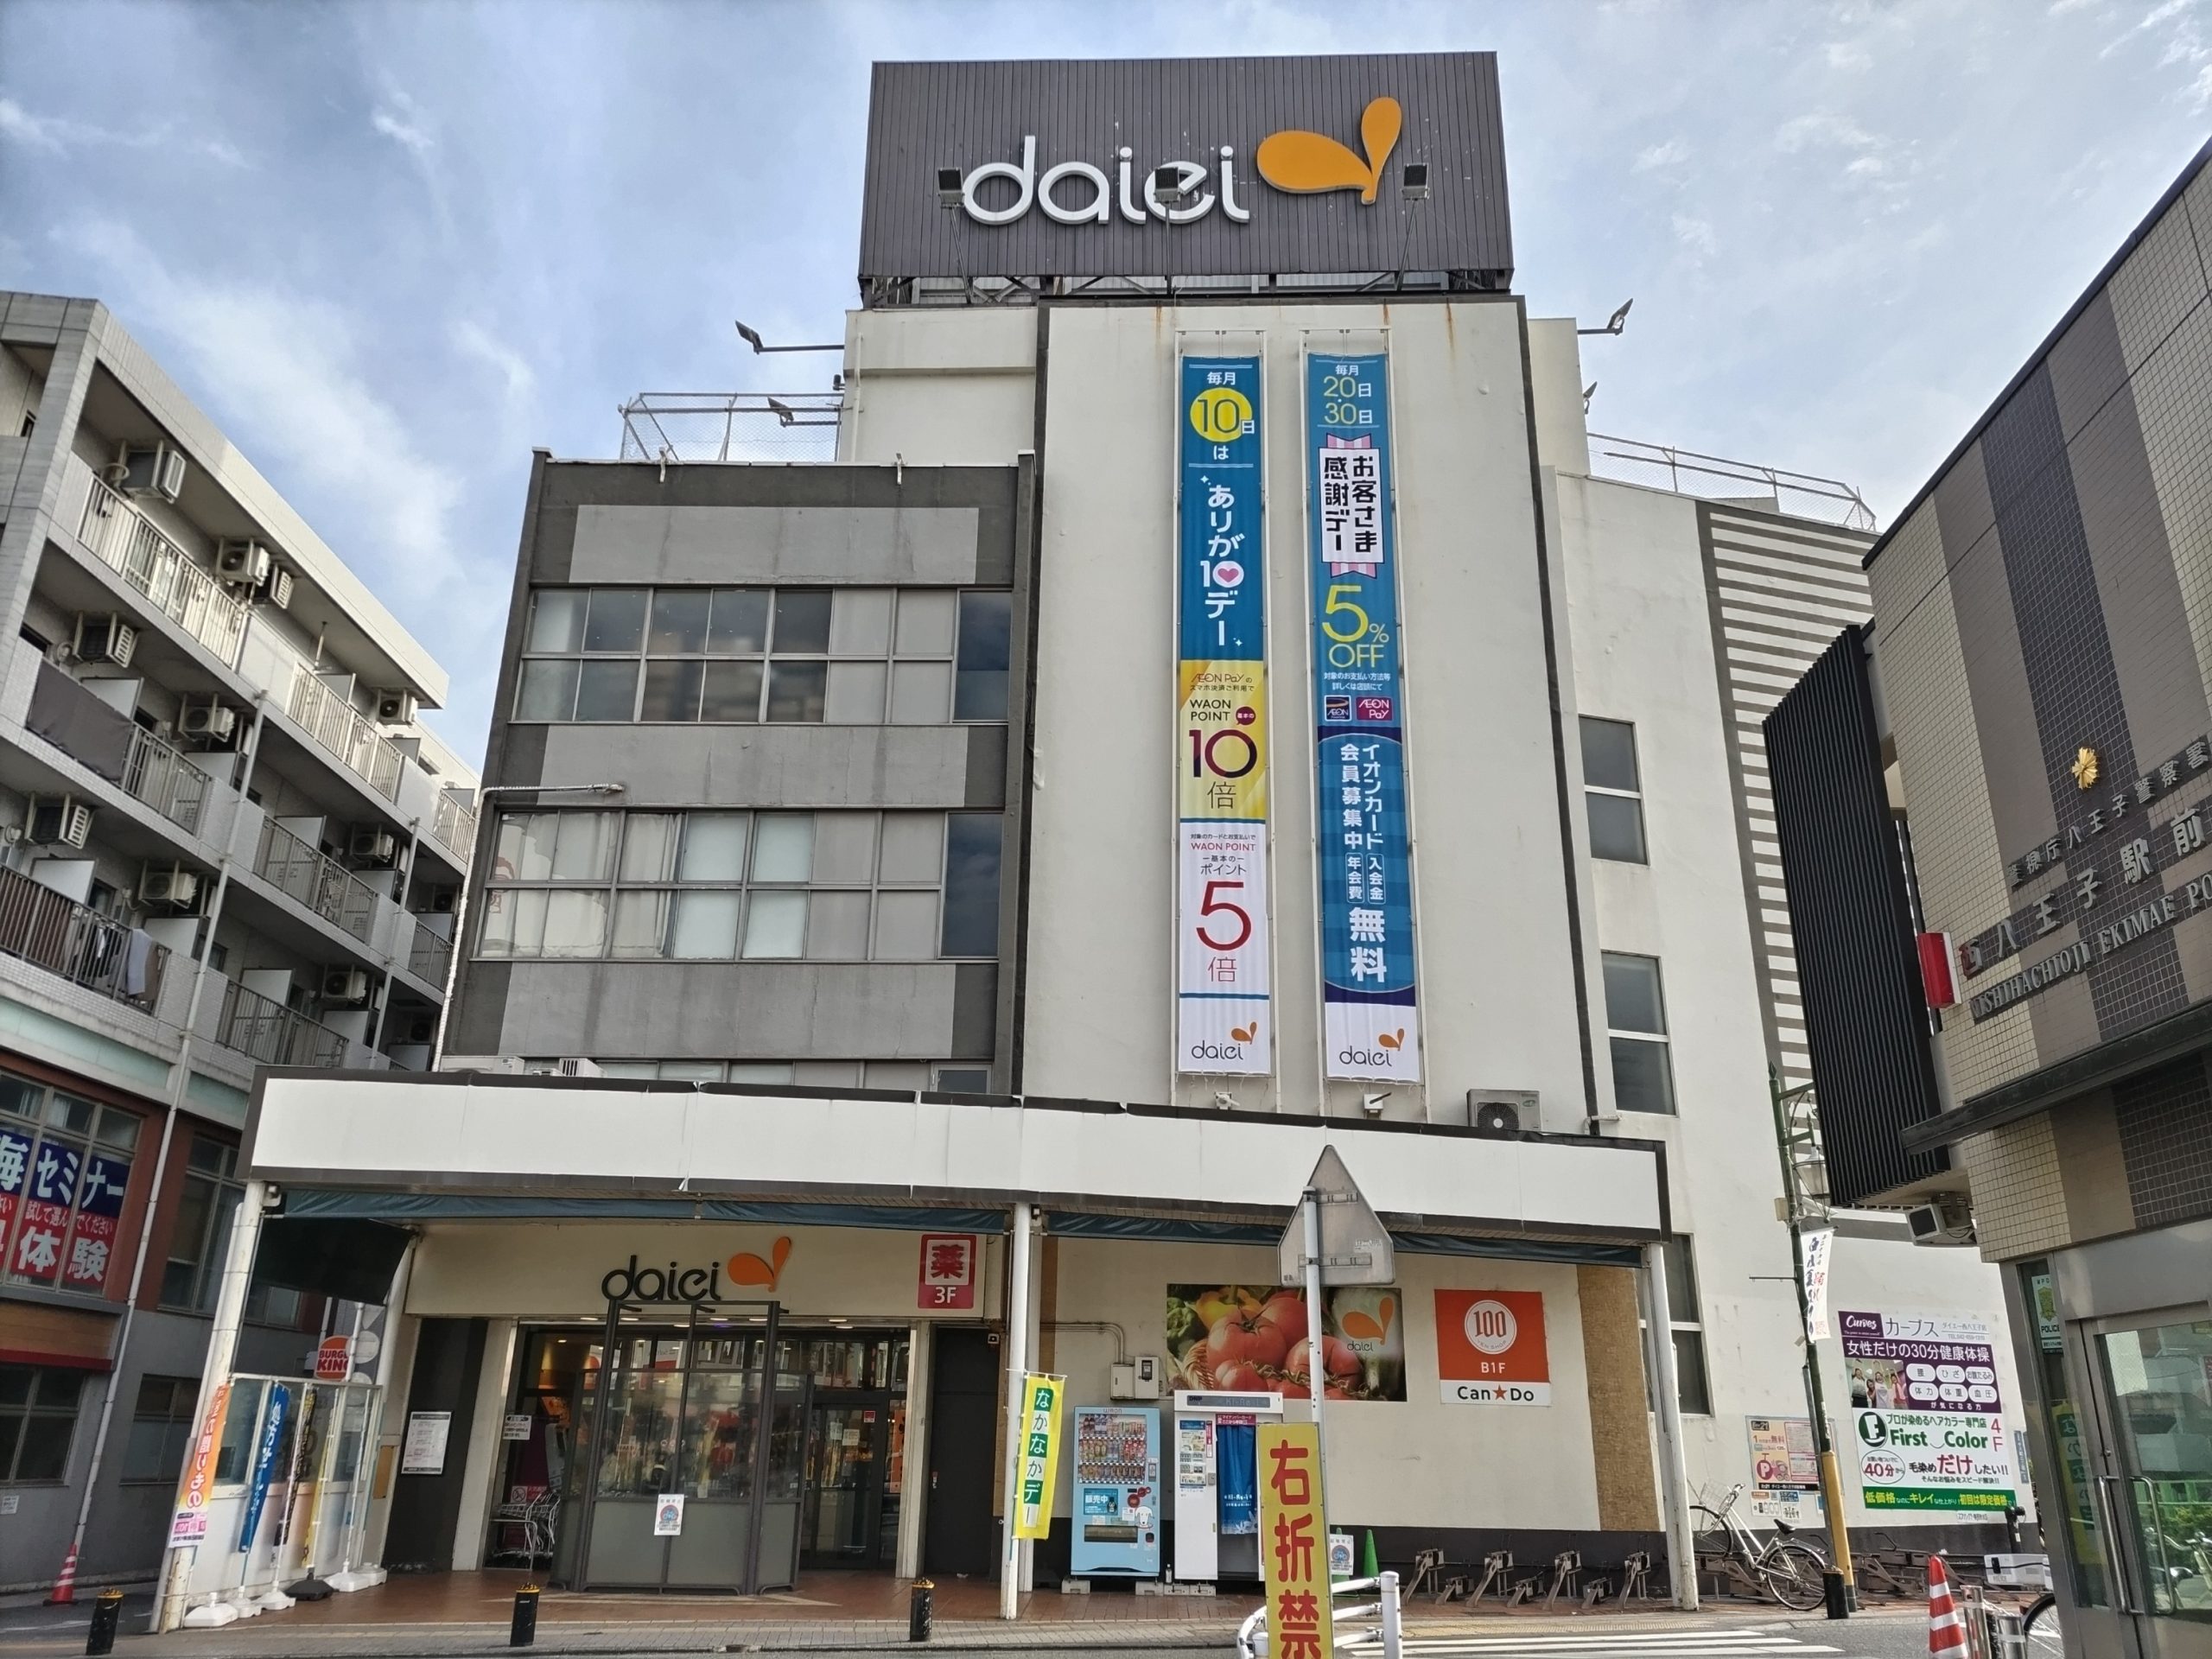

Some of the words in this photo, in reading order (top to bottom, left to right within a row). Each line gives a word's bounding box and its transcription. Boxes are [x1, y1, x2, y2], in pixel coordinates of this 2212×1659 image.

[963, 136, 1249, 225] daiei
[1206, 372, 1236, 385] 毎月
[1335, 365, 1359, 376] 毎月
[1323, 376, 1371, 397] 20日
[1197, 398, 1255, 434] 10日
[1324, 403, 1373, 424] 30日
[1213, 445, 1229, 460] は
[1324, 456, 1350, 551] 感謝デー
[1351, 455, 1377, 553] お客さま
[1322, 585, 1389, 643] 5%
[1328, 644, 1384, 668] OFF
[1324, 672, 1391, 681] 対象のお支払い方法等
[1332, 682, 1382, 690] 詳しくは店頭にて
[1190, 699, 1231, 709] WAON
[1191, 711, 1230, 721] POINT
[1189, 729, 1257, 778] 10
[1207, 781, 1236, 810] 倍
[1340, 743, 1363, 849] 会員募集中
[1362, 743, 1383, 850] イオンカード
[1225, 842, 1256, 851] POINT
[1200, 863, 1247, 875] ポイント
[1347, 855, 1363, 899] 年会費
[1369, 856, 1384, 900] 入会金
[1196, 880, 1252, 950] 5
[2098, 895, 2177, 955] EKIMAE
[1349, 906, 1387, 983] 無料
[1208, 957, 1237, 982] 倍
[1191, 1040, 1243, 1060] daiei
[1339, 1046, 1392, 1067] daiei
[931, 1244, 965, 1279] 薬
[601, 1255, 721, 1301] daiei
[934, 1287, 957, 1304] 3F
[1473, 1310, 1507, 1338] 100
[1847, 1315, 1877, 1330] Curves
[1885, 1318, 1939, 1338] カーブス
[2041, 1325, 2060, 1333] POLICE
[319, 1350, 349, 1359] BURG
[1347, 1340, 1374, 1352] daiei
[1847, 1340, 1991, 1363] 女性だけの30分健康体操
[1480, 1362, 1506, 1374] B1F
[1942, 1370, 1960, 1379] ひざ
[1457, 1386, 1491, 1400] Can
[1510, 1388, 1535, 1402] Do
[1915, 1387, 1934, 1395] 体力
[1944, 1388, 1963, 1397] 体重
[1974, 1389, 1993, 1398] 血圧
[1930, 1402, 1981, 1410] が気になる方
[1885, 1413, 1986, 1428] プロが染めるヘアカラー専門店
[1890, 1428, 1928, 1446] First
[1944, 1431, 1987, 1448] Color
[1023, 1389, 1052, 1522] なかなかデー
[1269, 1440, 1322, 1659] 右折禁
